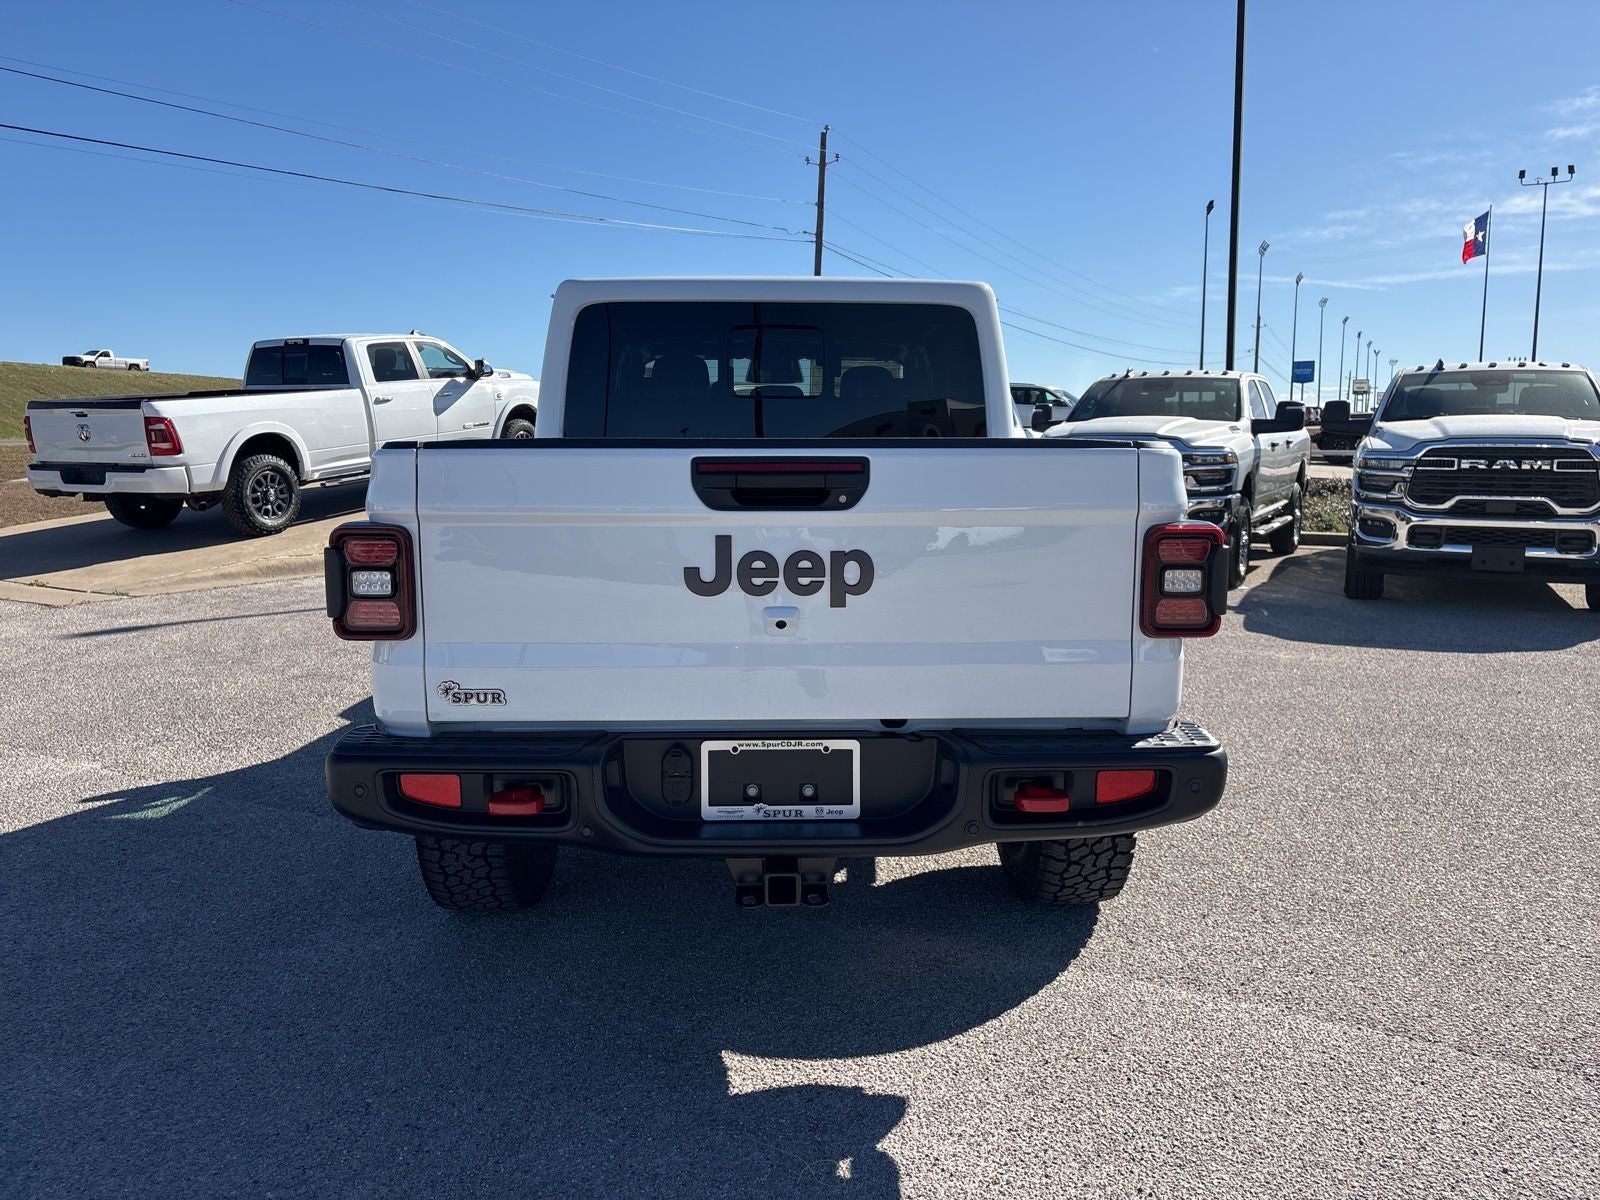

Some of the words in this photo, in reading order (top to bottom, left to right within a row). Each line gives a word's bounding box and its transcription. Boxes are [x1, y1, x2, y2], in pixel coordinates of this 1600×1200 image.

[1460, 459, 1552, 470] RAM
[683, 534, 875, 608] Jeep
[452, 692, 503, 703] SPUR
[763, 808, 804, 818] SPUR
[825, 808, 844, 816] Jeep
